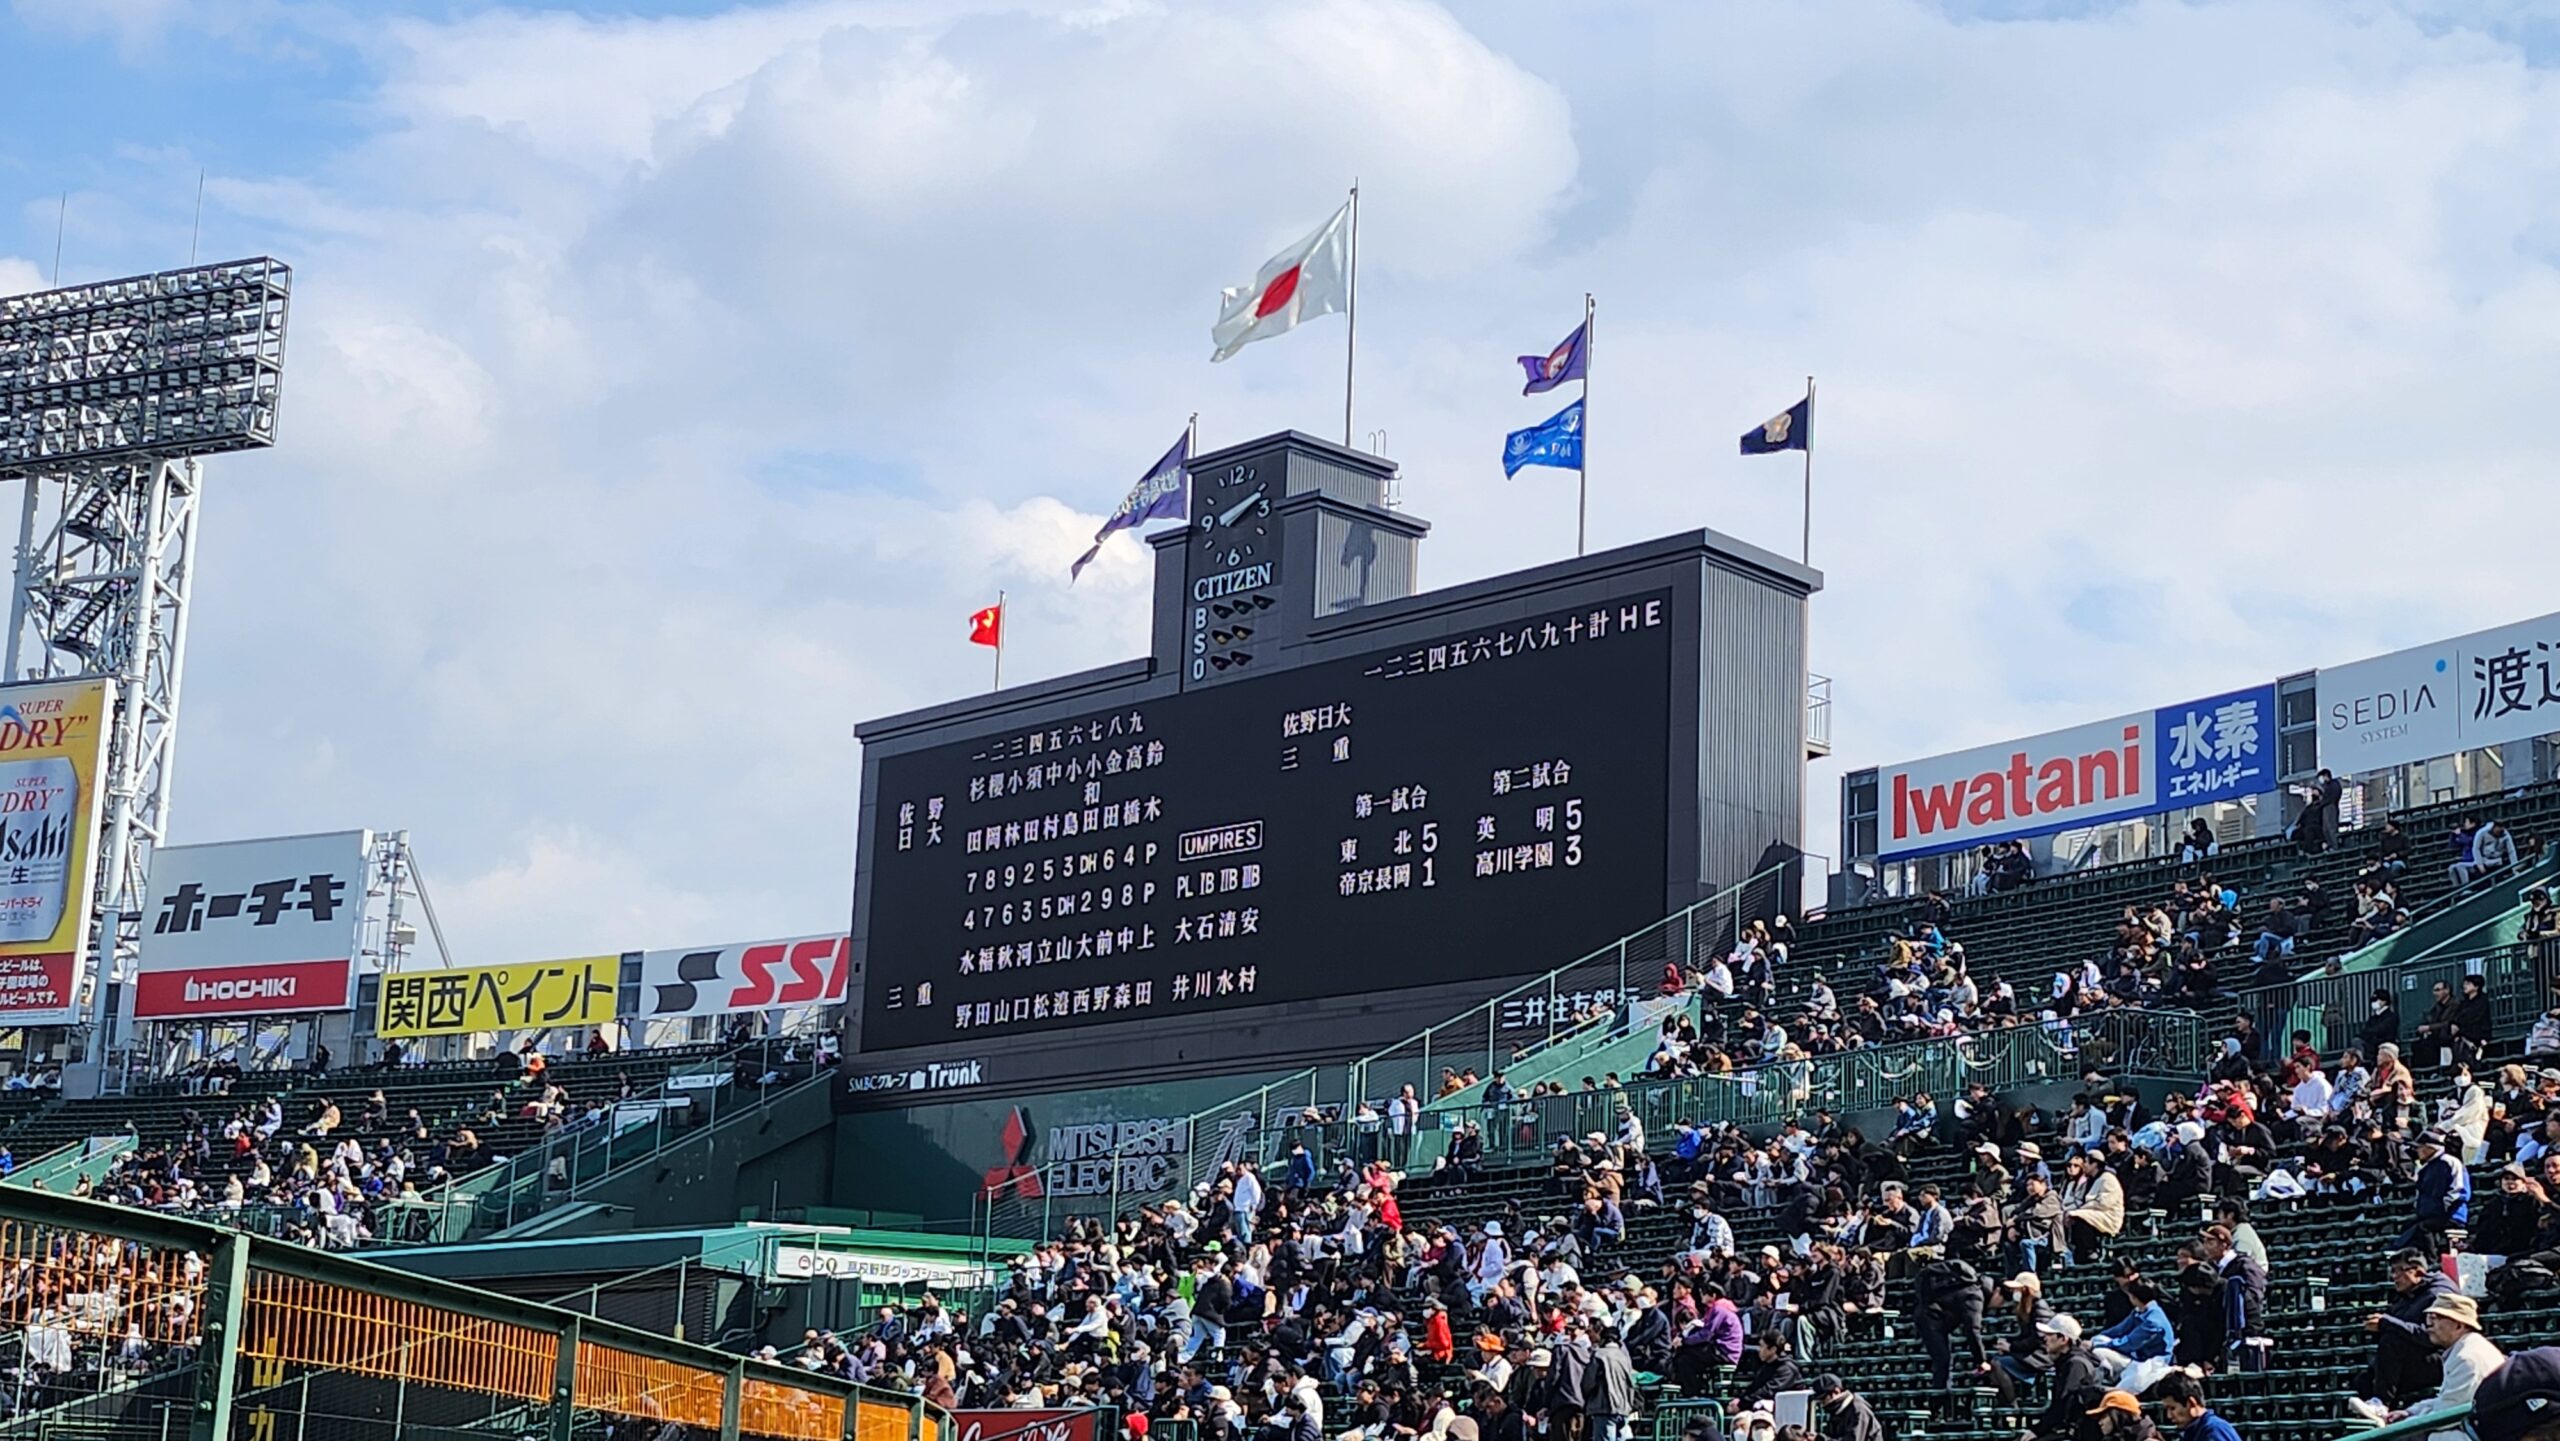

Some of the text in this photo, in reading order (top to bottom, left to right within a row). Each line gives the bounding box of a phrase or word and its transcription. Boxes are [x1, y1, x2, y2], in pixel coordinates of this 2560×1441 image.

[1230, 466, 1244, 484] 12
[1202, 502, 1270, 532] 9 3
[1228, 549, 1240, 566] 6
[1194, 562, 1273, 602] CITIZEN
[1195, 608, 1207, 629] B
[1620, 605, 1638, 632] H
[1646, 600, 1661, 626] E
[1194, 633, 1206, 654] S
[18, 700, 64, 715] SUPER
[1283, 702, 1352, 738] 佐野日大
[2169, 700, 2259, 769] 水素
[2361, 723, 2408, 745] SYSTEM
[15, 776, 48, 788] SUPER
[1492, 759, 1571, 796] 第二試合
[1893, 724, 2140, 840] Iwatani
[2169, 762, 2259, 798] エネルギー
[1356, 784, 1428, 819] 第一試合
[1566, 799, 1582, 830] 5
[1185, 827, 1256, 855] UMPIRES
[1422, 823, 1437, 853] 5
[1565, 835, 1581, 865] 3
[10, 865, 30, 885] 生
[1177, 875, 1194, 899] PL
[1339, 857, 1435, 896] 帝京長岡 1
[153, 873, 346, 934] ホーチキ
[200, 976, 296, 1002] HOCHIKI
[383, 964, 615, 1031] 関西ペイント
[928, 1060, 982, 1089] Trunk
[1050, 1115, 1187, 1161] MITSUBISHI
[1050, 1157, 1169, 1196] ELECTRIC
